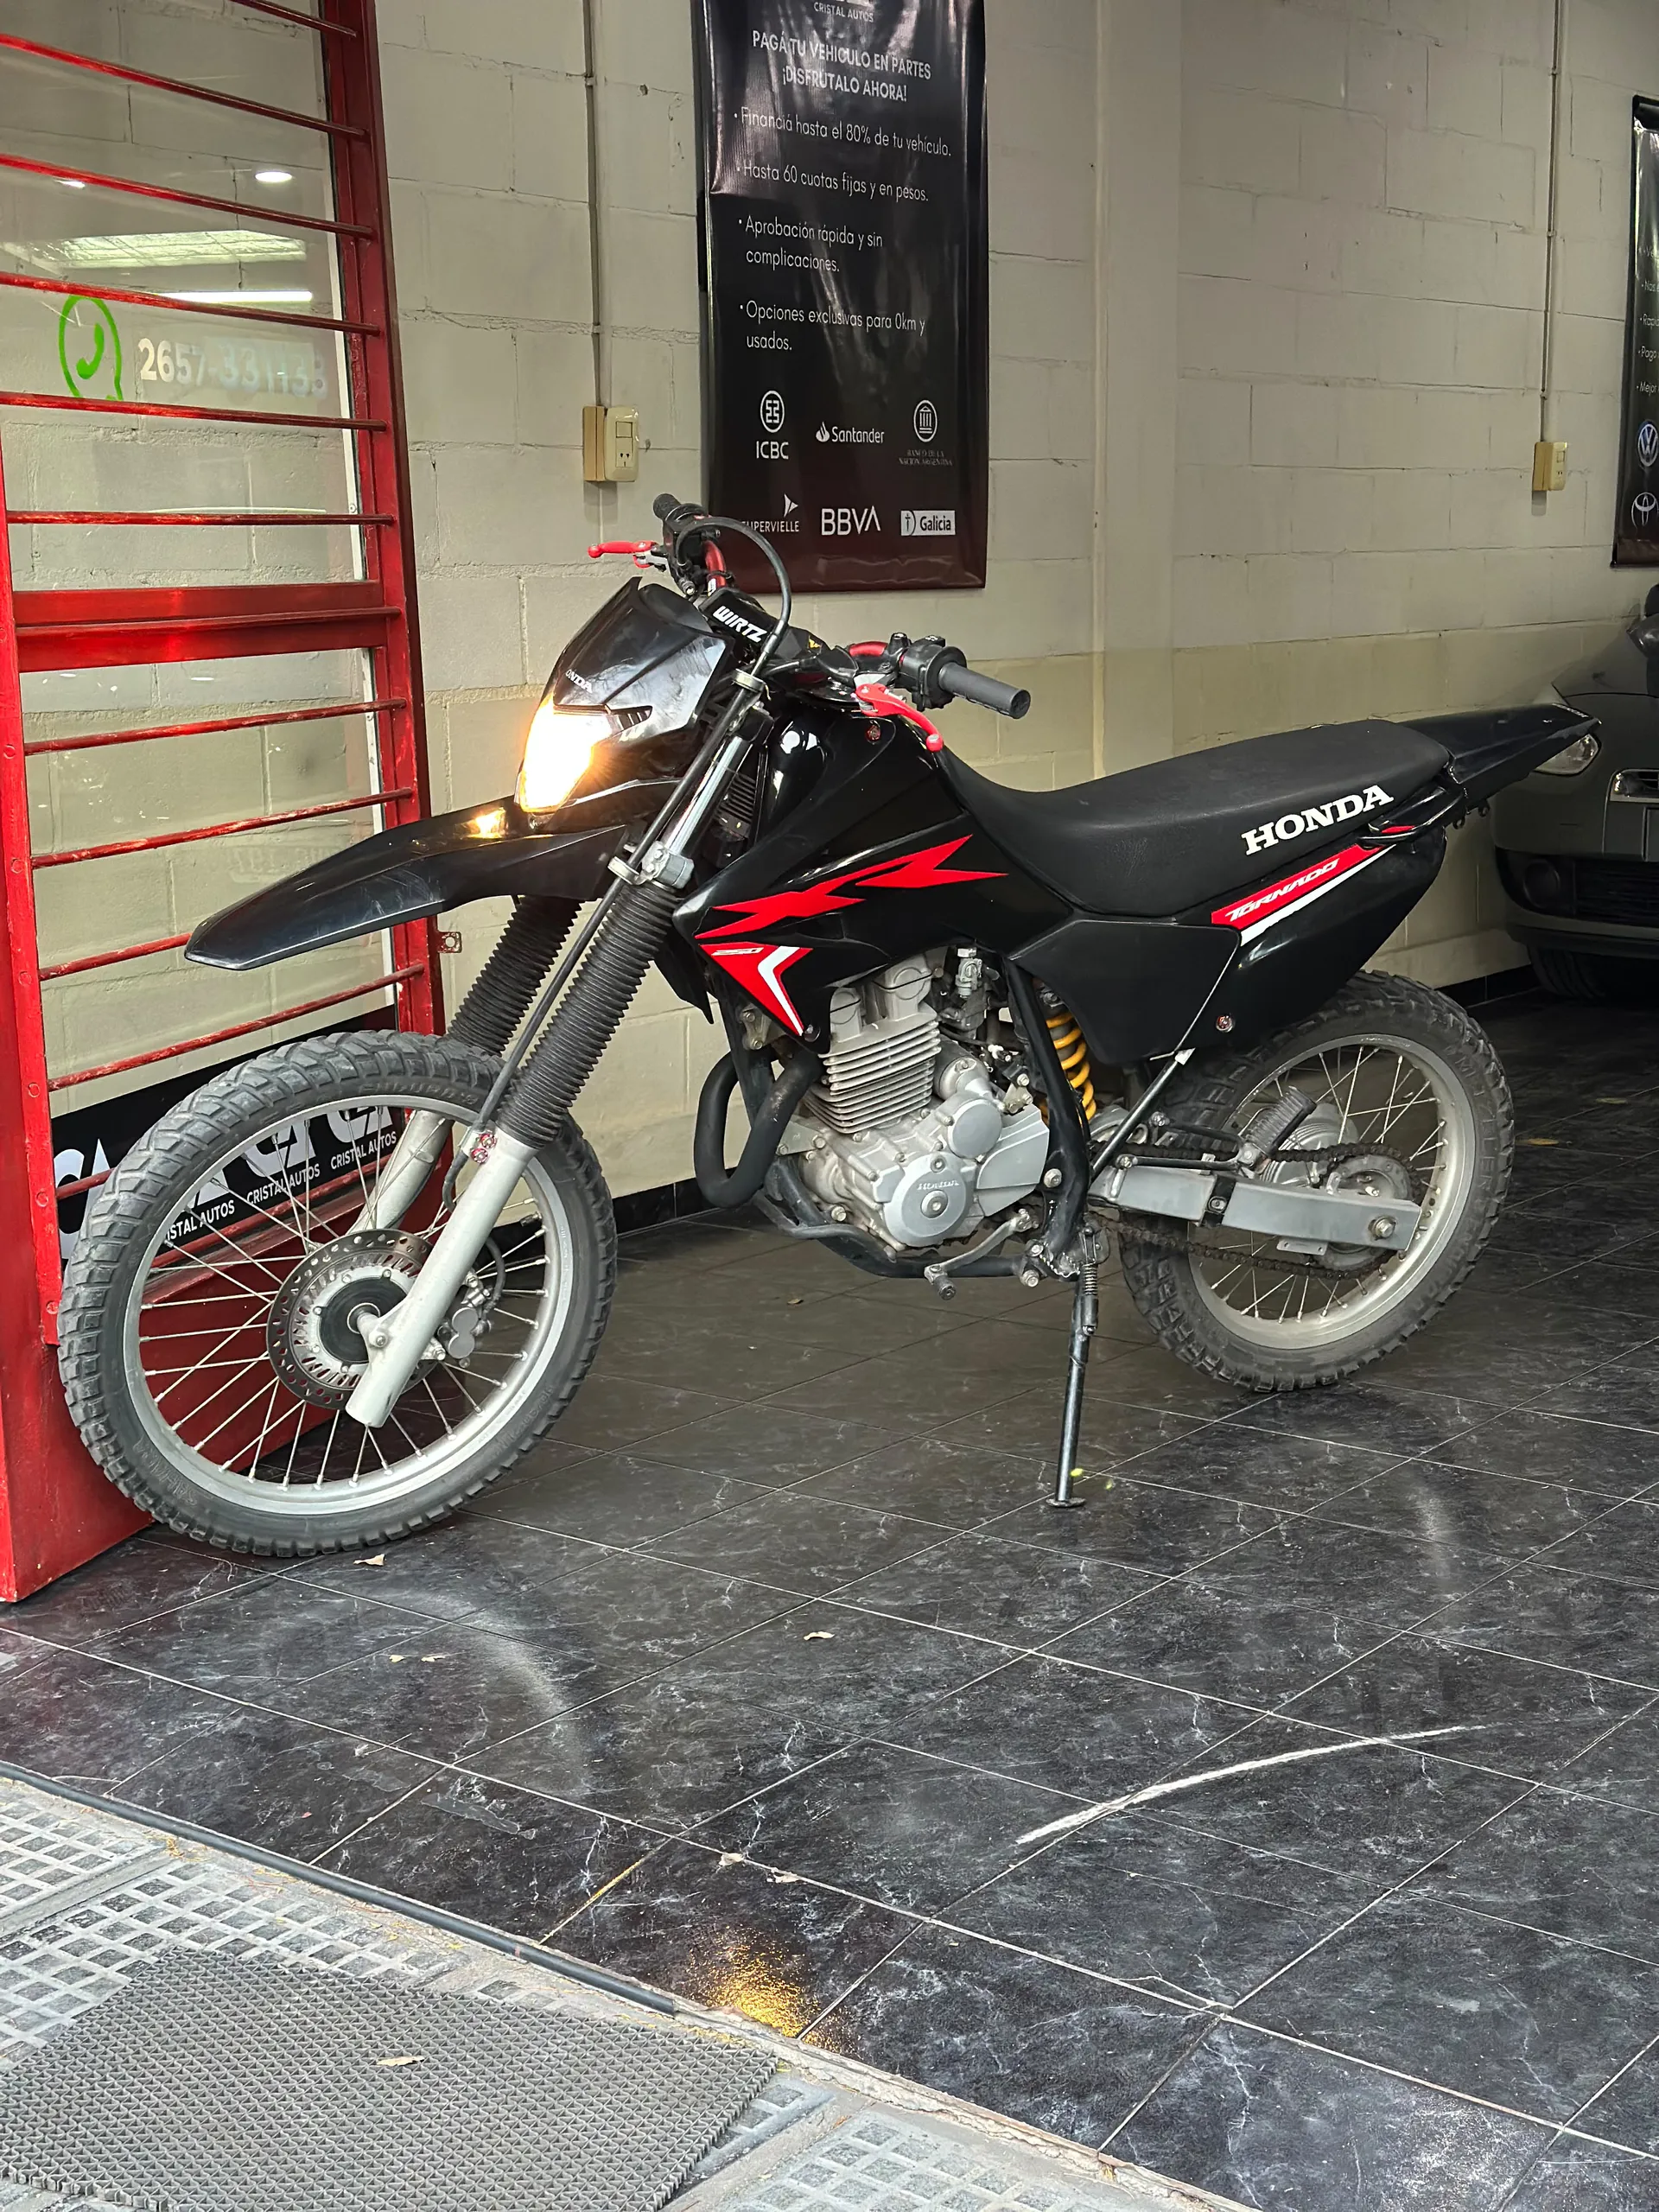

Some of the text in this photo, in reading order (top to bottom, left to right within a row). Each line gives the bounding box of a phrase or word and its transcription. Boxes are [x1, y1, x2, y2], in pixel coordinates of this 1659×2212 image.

[814, 2, 845, 17] CRISTAL
[848, 9, 874, 22] AUTOS
[753, 30, 786, 52] PAGÁ
[790, 38, 804, 56] TU
[874, 54, 887, 72] EN
[892, 58, 931, 79] PARTES
[863, 79, 907, 102] AHORA!
[741, 107, 951, 156] Financiá hasta el 80% de tu vehículo.
[744, 163, 929, 202] Hasta 60 cuotas fijas y en pesos.
[745, 215, 882, 251] Aprobación rápida y sin
[746, 247, 840, 273] complicaciones.
[746, 300, 925, 336] Opciones exclusivas para 0km y
[747, 332, 792, 351] usados.
[756, 441, 789, 460] ICBC
[831, 426, 885, 443] Santander
[821, 505, 881, 536] BBVA
[920, 515, 951, 531] Galicia
[713, 606, 767, 643] WIRTZ
[1241, 785, 1394, 855] HONDA
[1225, 858, 1339, 922] TORNADO
[330, 1147, 366, 1169] CRISTAL
[368, 1131, 397, 1153] AUTOS
[247, 1178, 286, 1205] CRISTAL
[289, 1163, 320, 1189] AUTOS
[167, 1199, 234, 1240] ISTAL AUTOS
